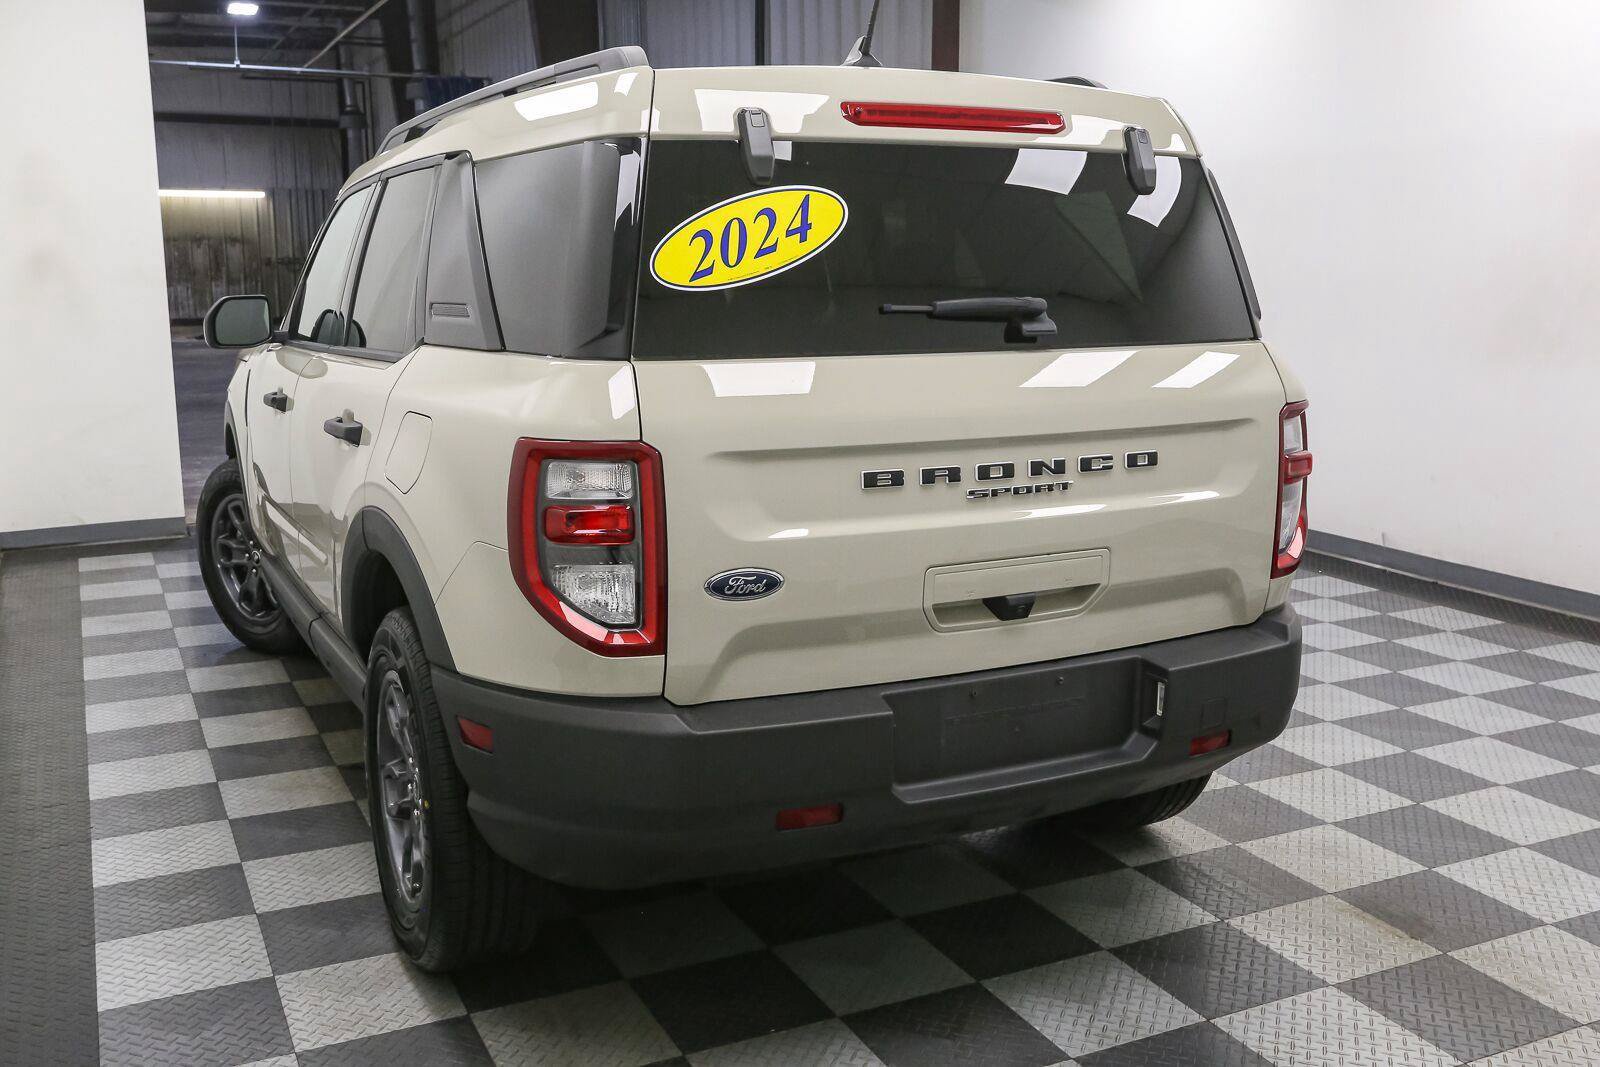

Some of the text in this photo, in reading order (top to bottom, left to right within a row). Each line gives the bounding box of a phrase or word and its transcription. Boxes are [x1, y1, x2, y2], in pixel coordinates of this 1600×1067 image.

[689, 194, 812, 282] 2024
[861, 450, 1158, 490] BRONCO
[966, 480, 1074, 500] SPORT
[724, 576, 767, 594] Ford
